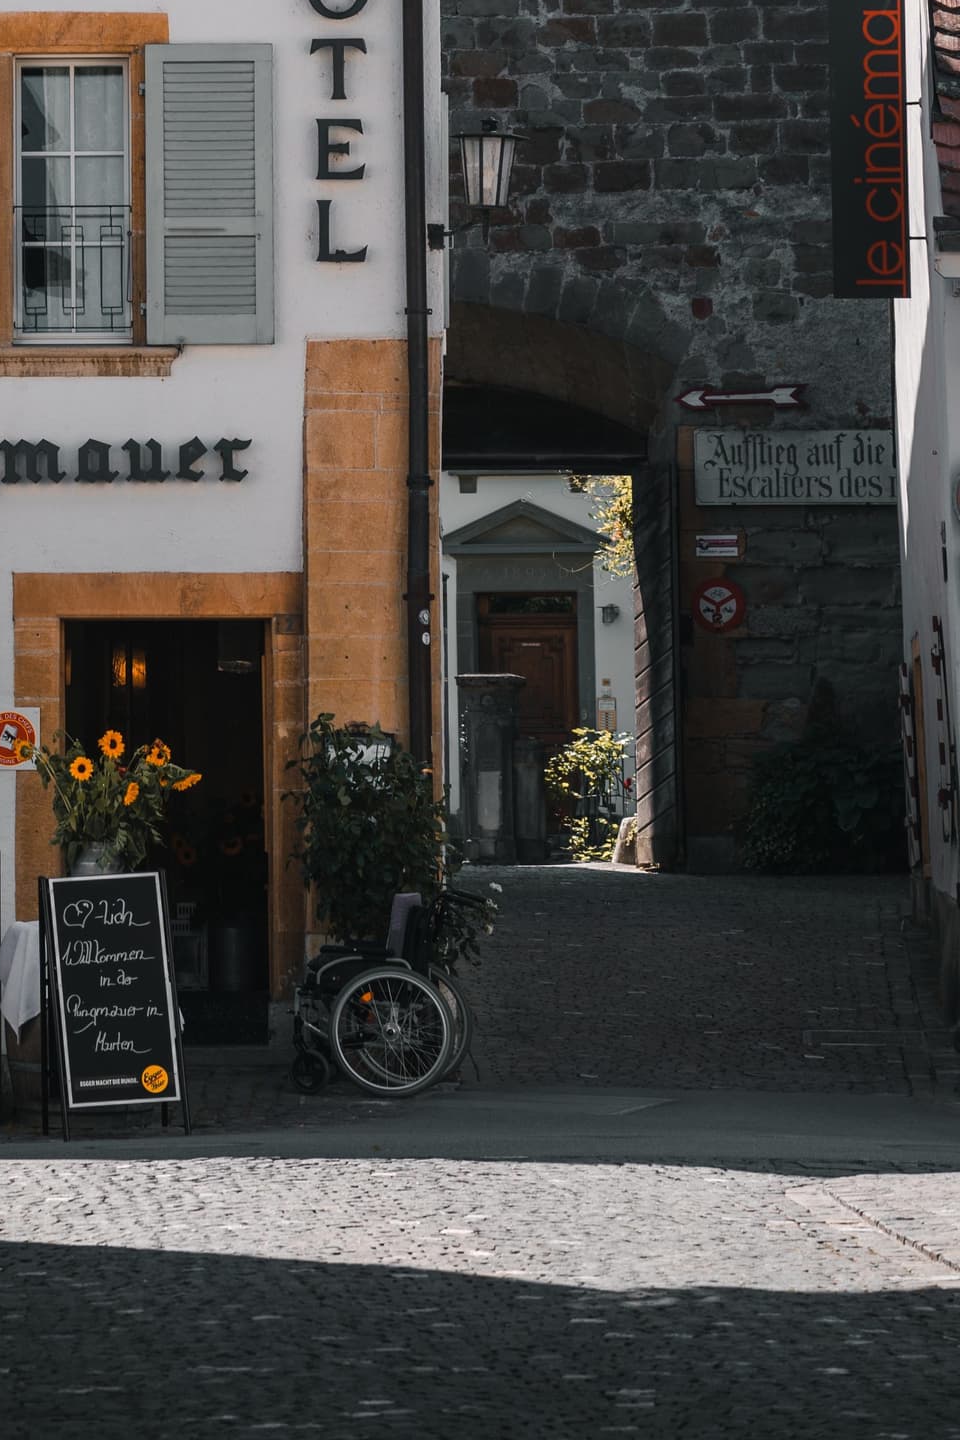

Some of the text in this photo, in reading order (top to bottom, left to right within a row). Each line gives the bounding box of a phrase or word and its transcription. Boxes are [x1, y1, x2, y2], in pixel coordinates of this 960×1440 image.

[850, 10, 904, 286] le cinéma
[806, 432, 847, 472] auf
[852, 432, 885, 466] die
[718, 467, 833, 498] Escaliers
[839, 467, 884, 498] des
[99, 968, 139, 987] in der
[146, 999, 164, 1017] in
